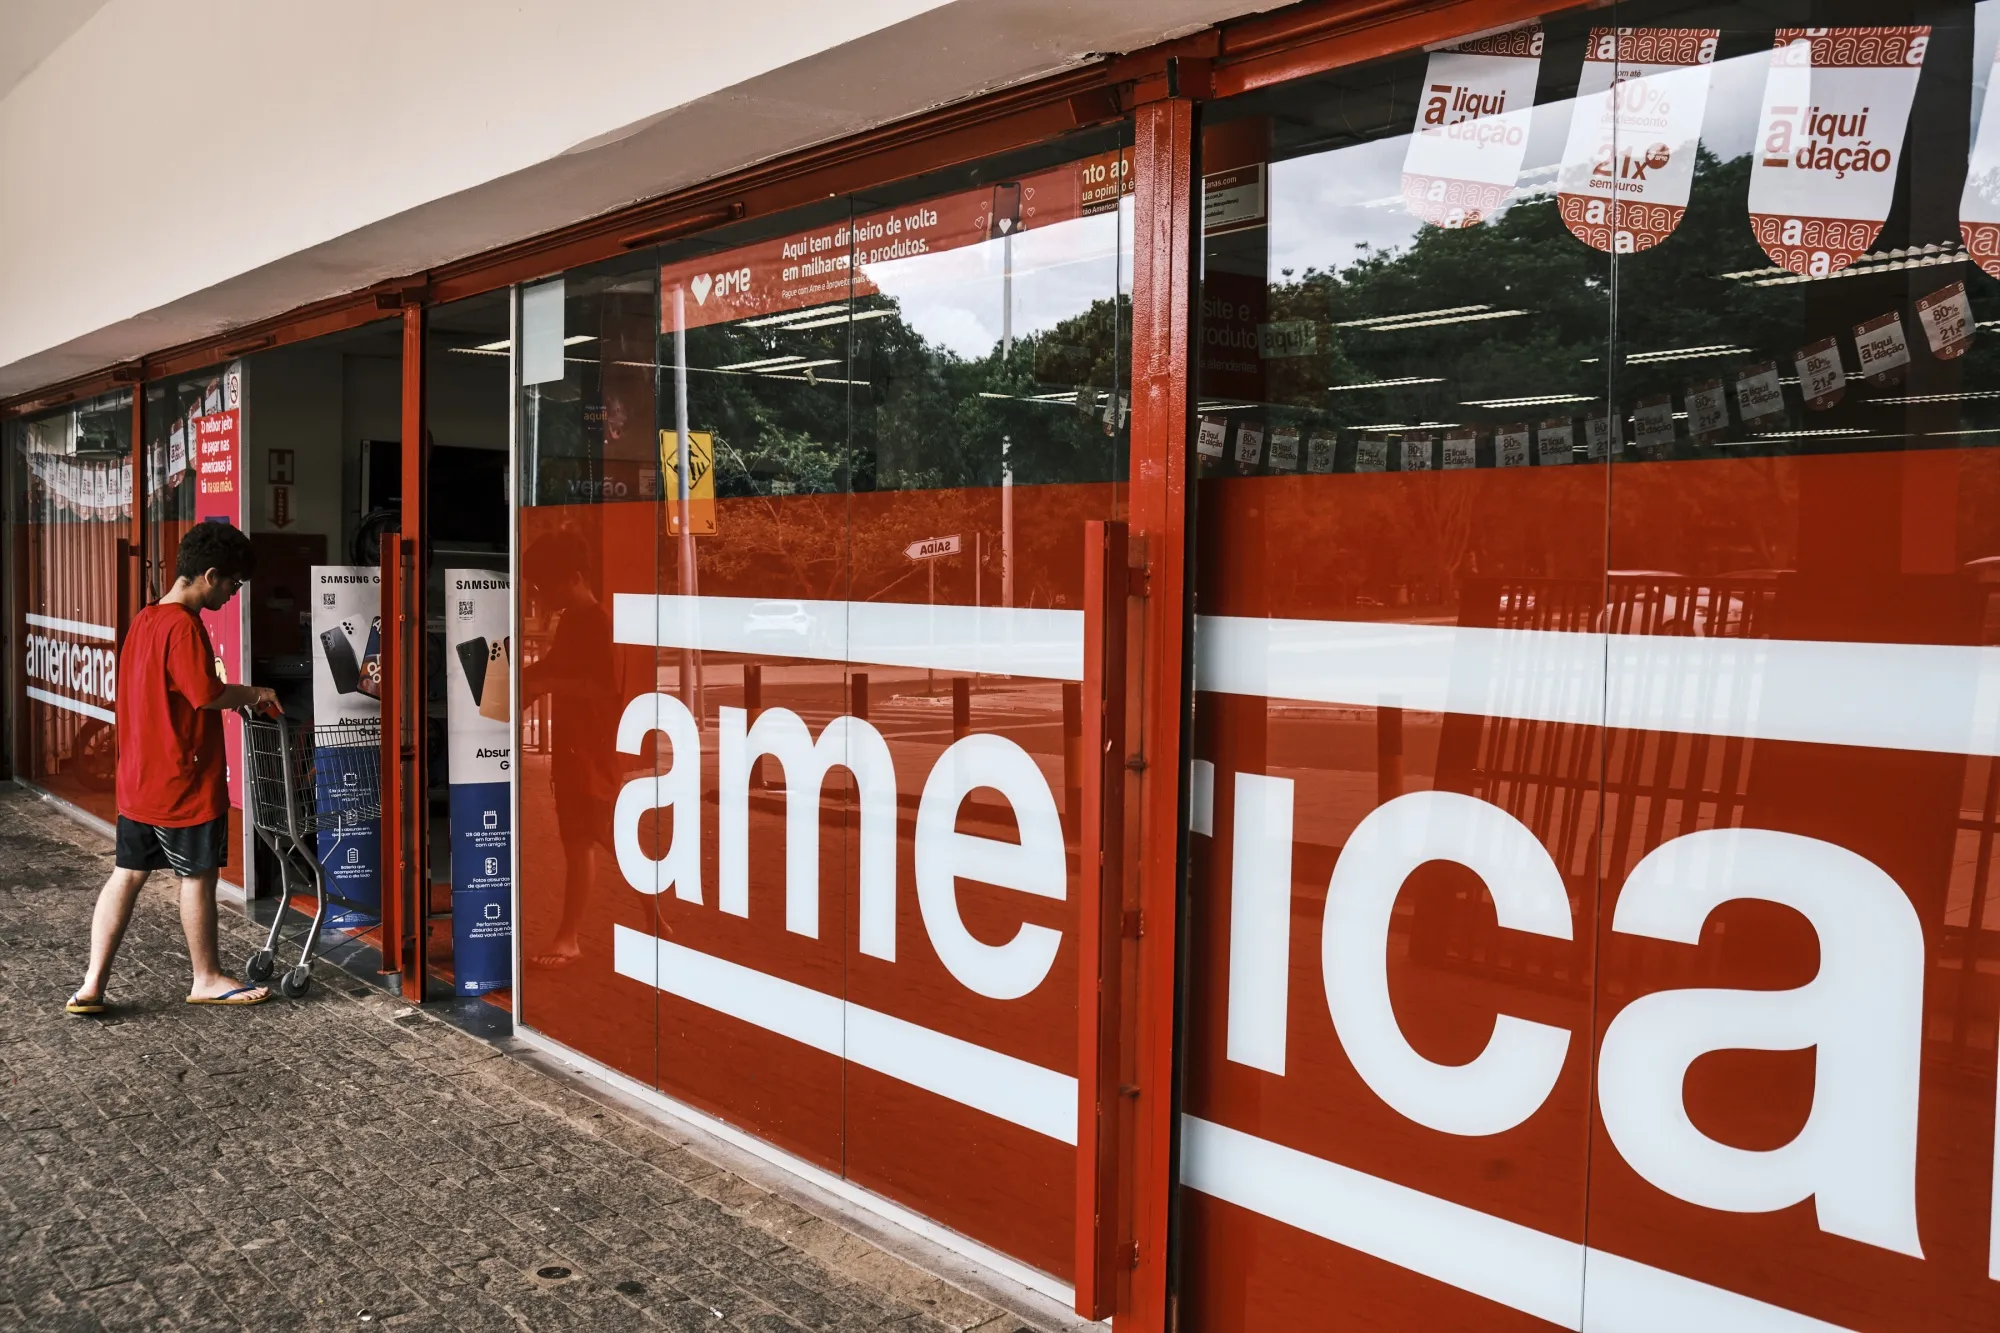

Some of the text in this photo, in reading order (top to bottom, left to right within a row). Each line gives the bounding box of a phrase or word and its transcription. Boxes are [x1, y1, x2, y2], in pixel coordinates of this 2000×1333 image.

[1452, 87, 1506, 119] liqui
[1448, 115, 1523, 149] dação
[1800, 107, 1869, 144] liqui
[1796, 140, 1891, 179] dação
[1110, 159, 1129, 180] ao
[1095, 182, 1127, 199] opinio
[1589, 179, 1613, 189] sem
[783, 209, 937, 260] Aqui tem dinheiro de volta
[783, 237, 929, 282] em milhares de produtos.
[798, 284, 809, 296] com
[1932, 303, 1959, 322] 80%
[1264, 324, 1309, 353] aqui!
[1940, 324, 1962, 342] 21x
[1871, 336, 1893, 352] liqui
[1873, 341, 1905, 361] dação
[1807, 358, 1830, 373] 80%
[584, 408, 608, 423] aqui!
[221, 438, 230, 452] nas
[568, 476, 627, 497] verão
[320, 576, 369, 584] SAMSUNG
